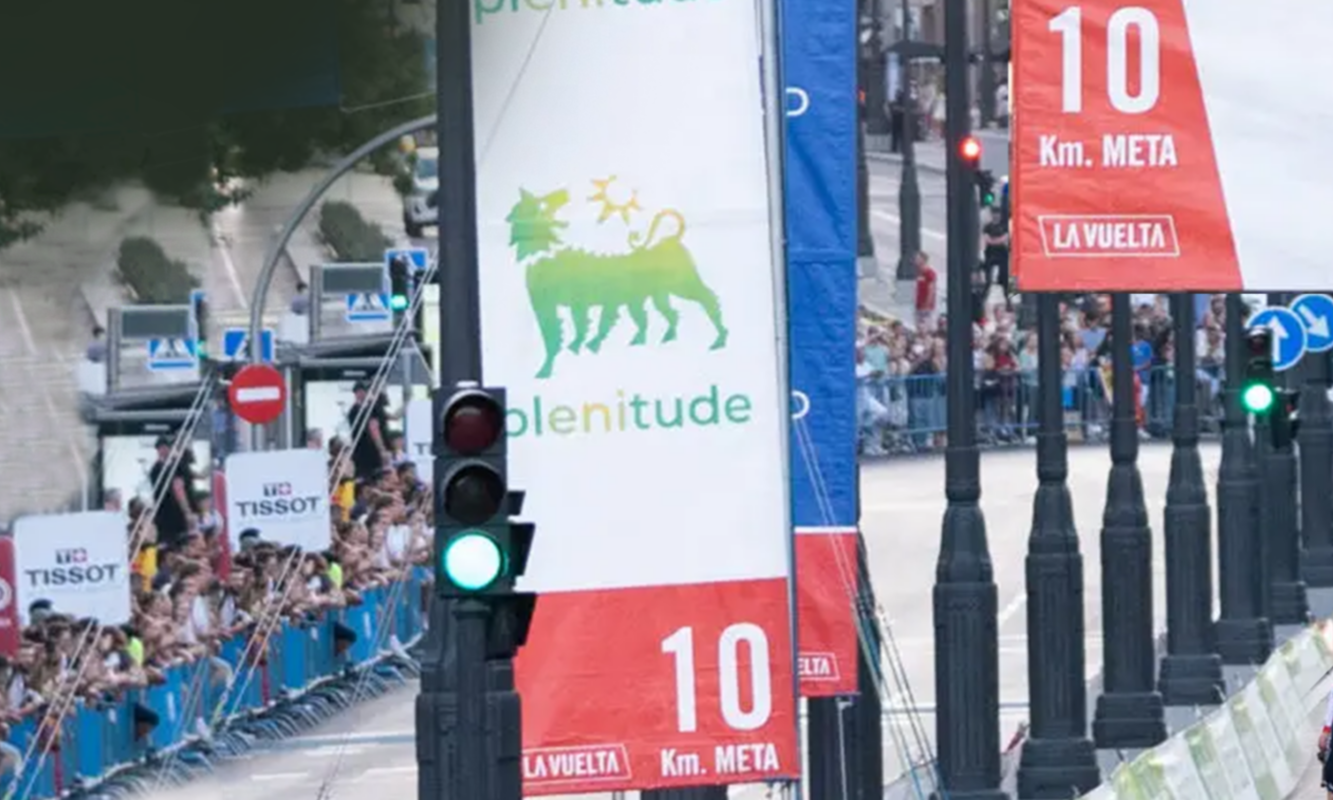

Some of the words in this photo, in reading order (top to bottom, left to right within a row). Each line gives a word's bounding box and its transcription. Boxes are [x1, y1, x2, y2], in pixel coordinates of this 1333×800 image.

[1048, 6, 1160, 114] 10
[1039, 135, 1092, 166] Km.
[1103, 134, 1177, 166] META
[1053, 223, 1079, 248] LA
[1083, 223, 1165, 248] VUELTA
[235, 497, 321, 518] TISSOT
[25, 564, 121, 586] TISSOT
[661, 623, 773, 733] 10
[548, 751, 620, 777] VUELTA
[661, 749, 706, 777] Km.
[715, 744, 779, 773] META
